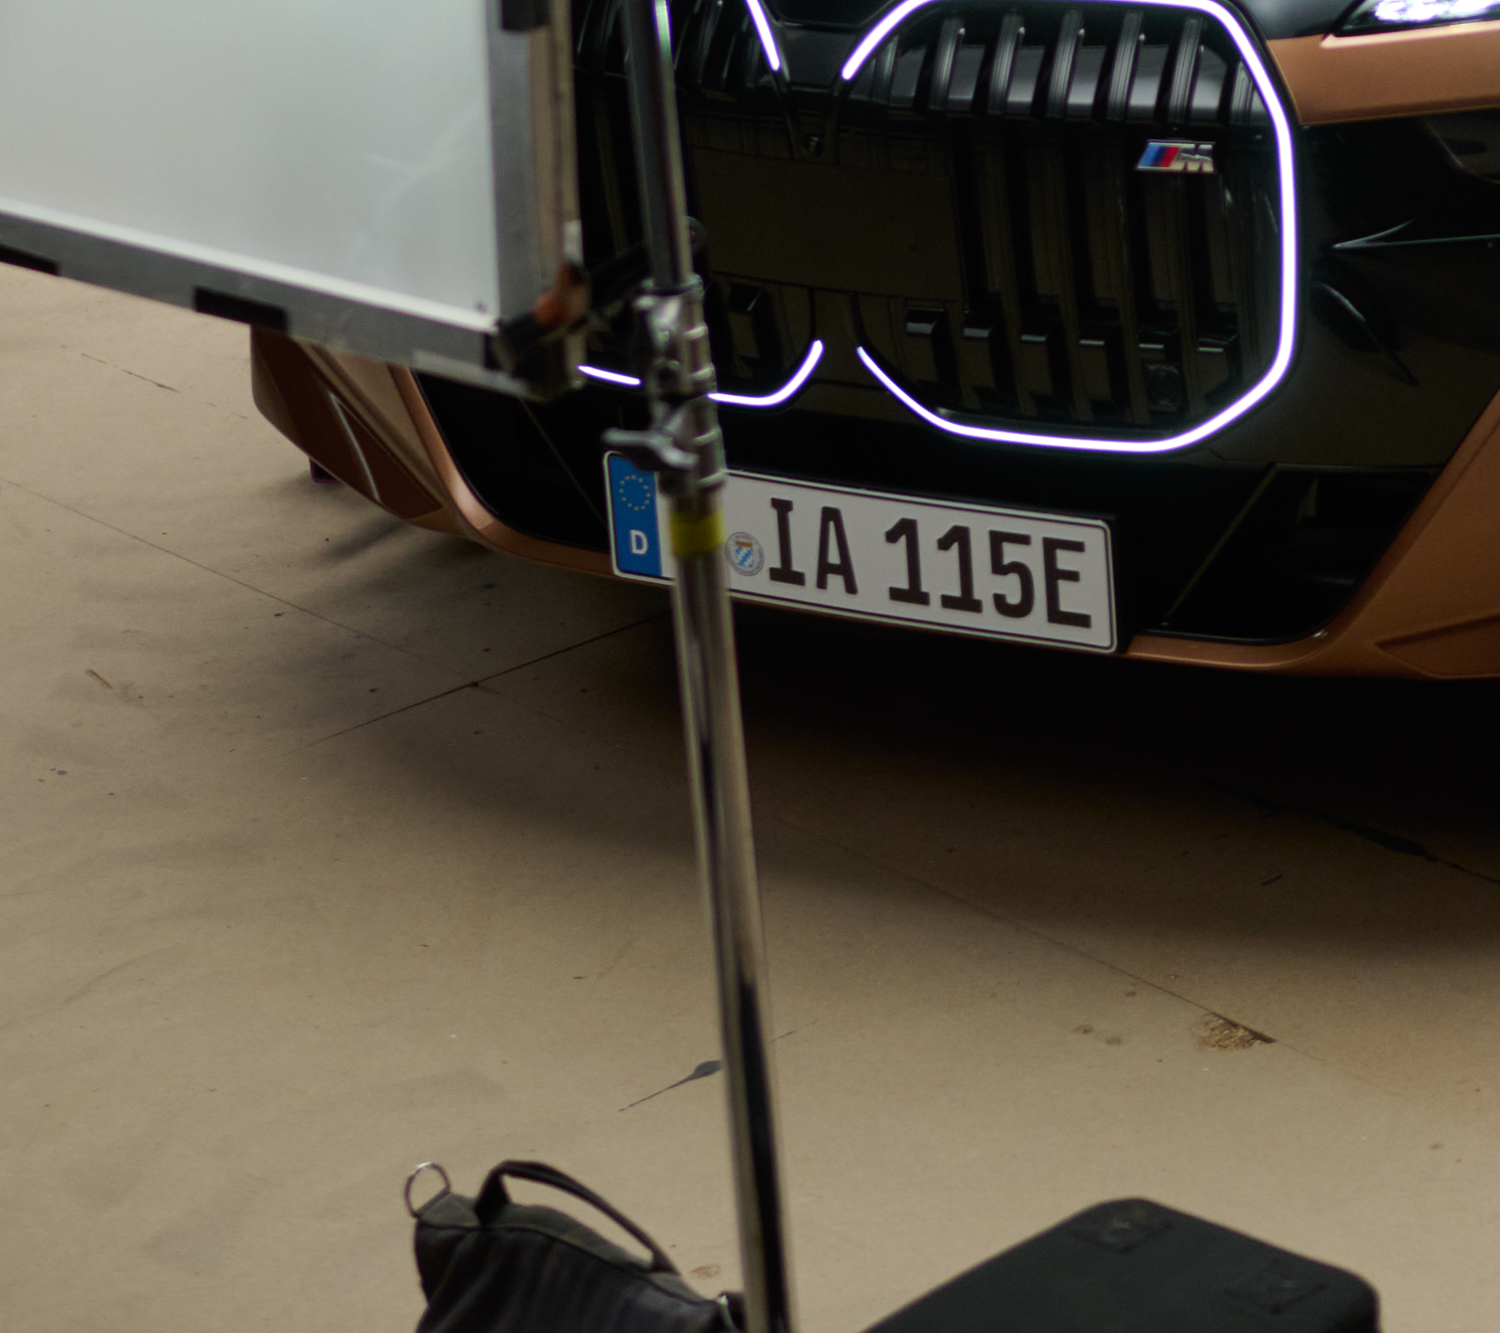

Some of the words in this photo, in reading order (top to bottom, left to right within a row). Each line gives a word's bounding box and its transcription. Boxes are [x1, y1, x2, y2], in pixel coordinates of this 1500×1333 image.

[628, 528, 649, 556] D
[769, 497, 859, 596] IA
[884, 518, 1092, 629] 115E
